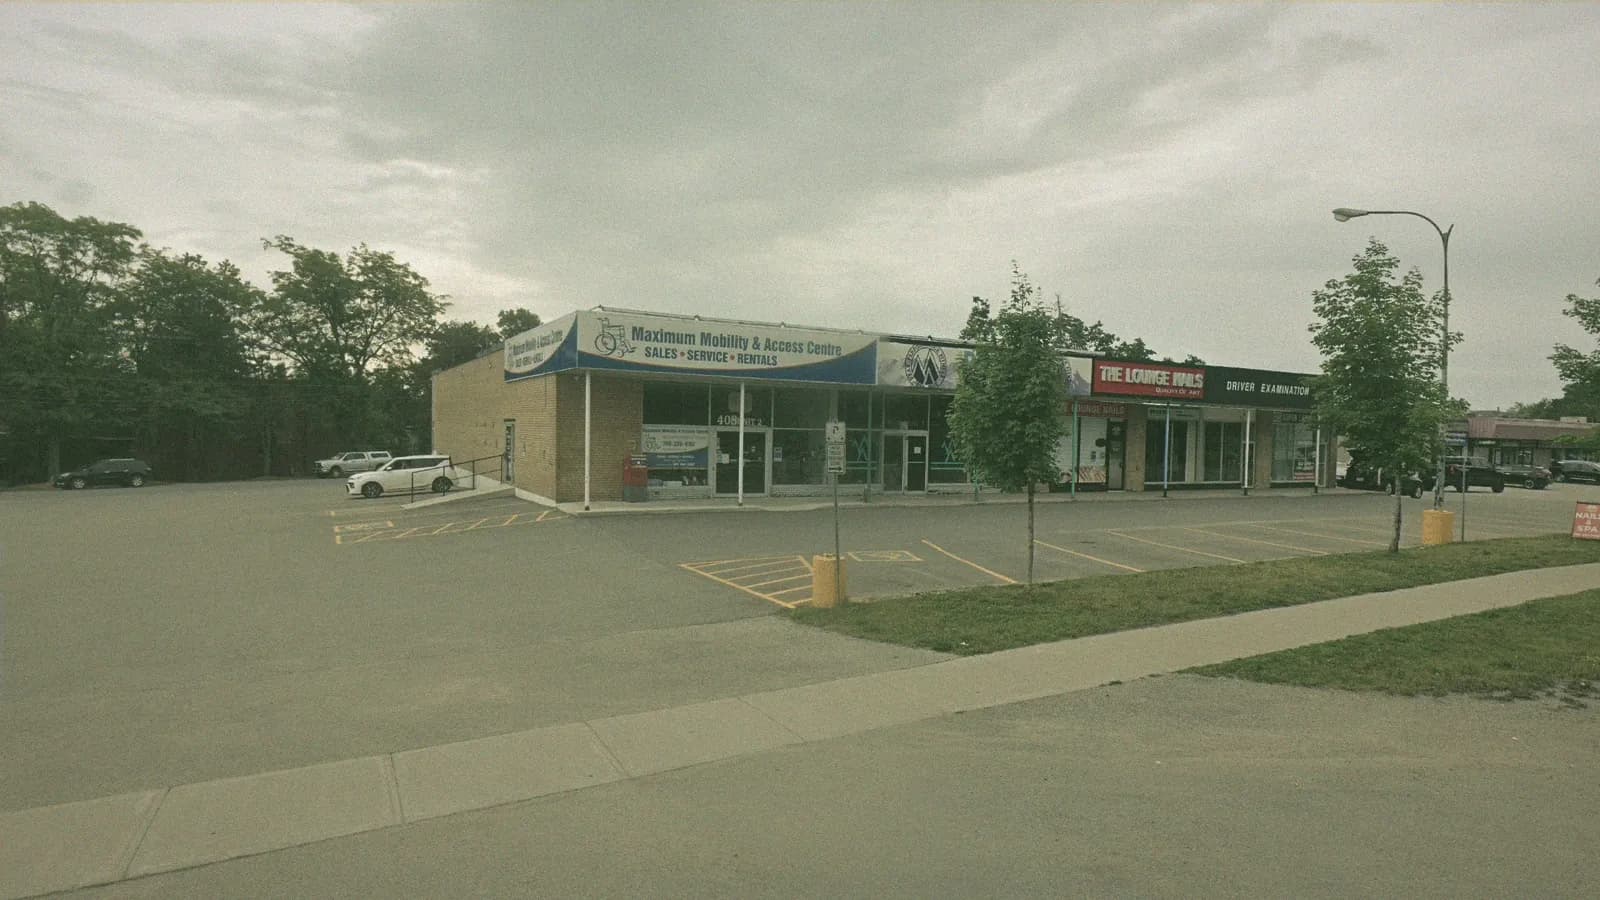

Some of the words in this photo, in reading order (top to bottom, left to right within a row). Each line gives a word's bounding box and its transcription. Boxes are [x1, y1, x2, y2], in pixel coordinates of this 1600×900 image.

[631, 326, 696, 345] Maximum
[700, 332, 749, 351] Mobility
[752, 336, 760, 350] &
[763, 338, 804, 354] Access
[807, 341, 842, 356] Centre
[645, 346, 678, 359] SALES
[687, 350, 729, 363] SERVICE
[737, 353, 778, 366] RENTALS
[1100, 366, 1123, 382] THE
[1125, 368, 1171, 386] LOUNGE
[1172, 372, 1204, 388] NAILS
[1226, 380, 1256, 392] DRIVER
[1261, 383, 1310, 396] EXAMINATION
[717, 414, 737, 425] 408
[1577, 525, 1598, 533] SPA
